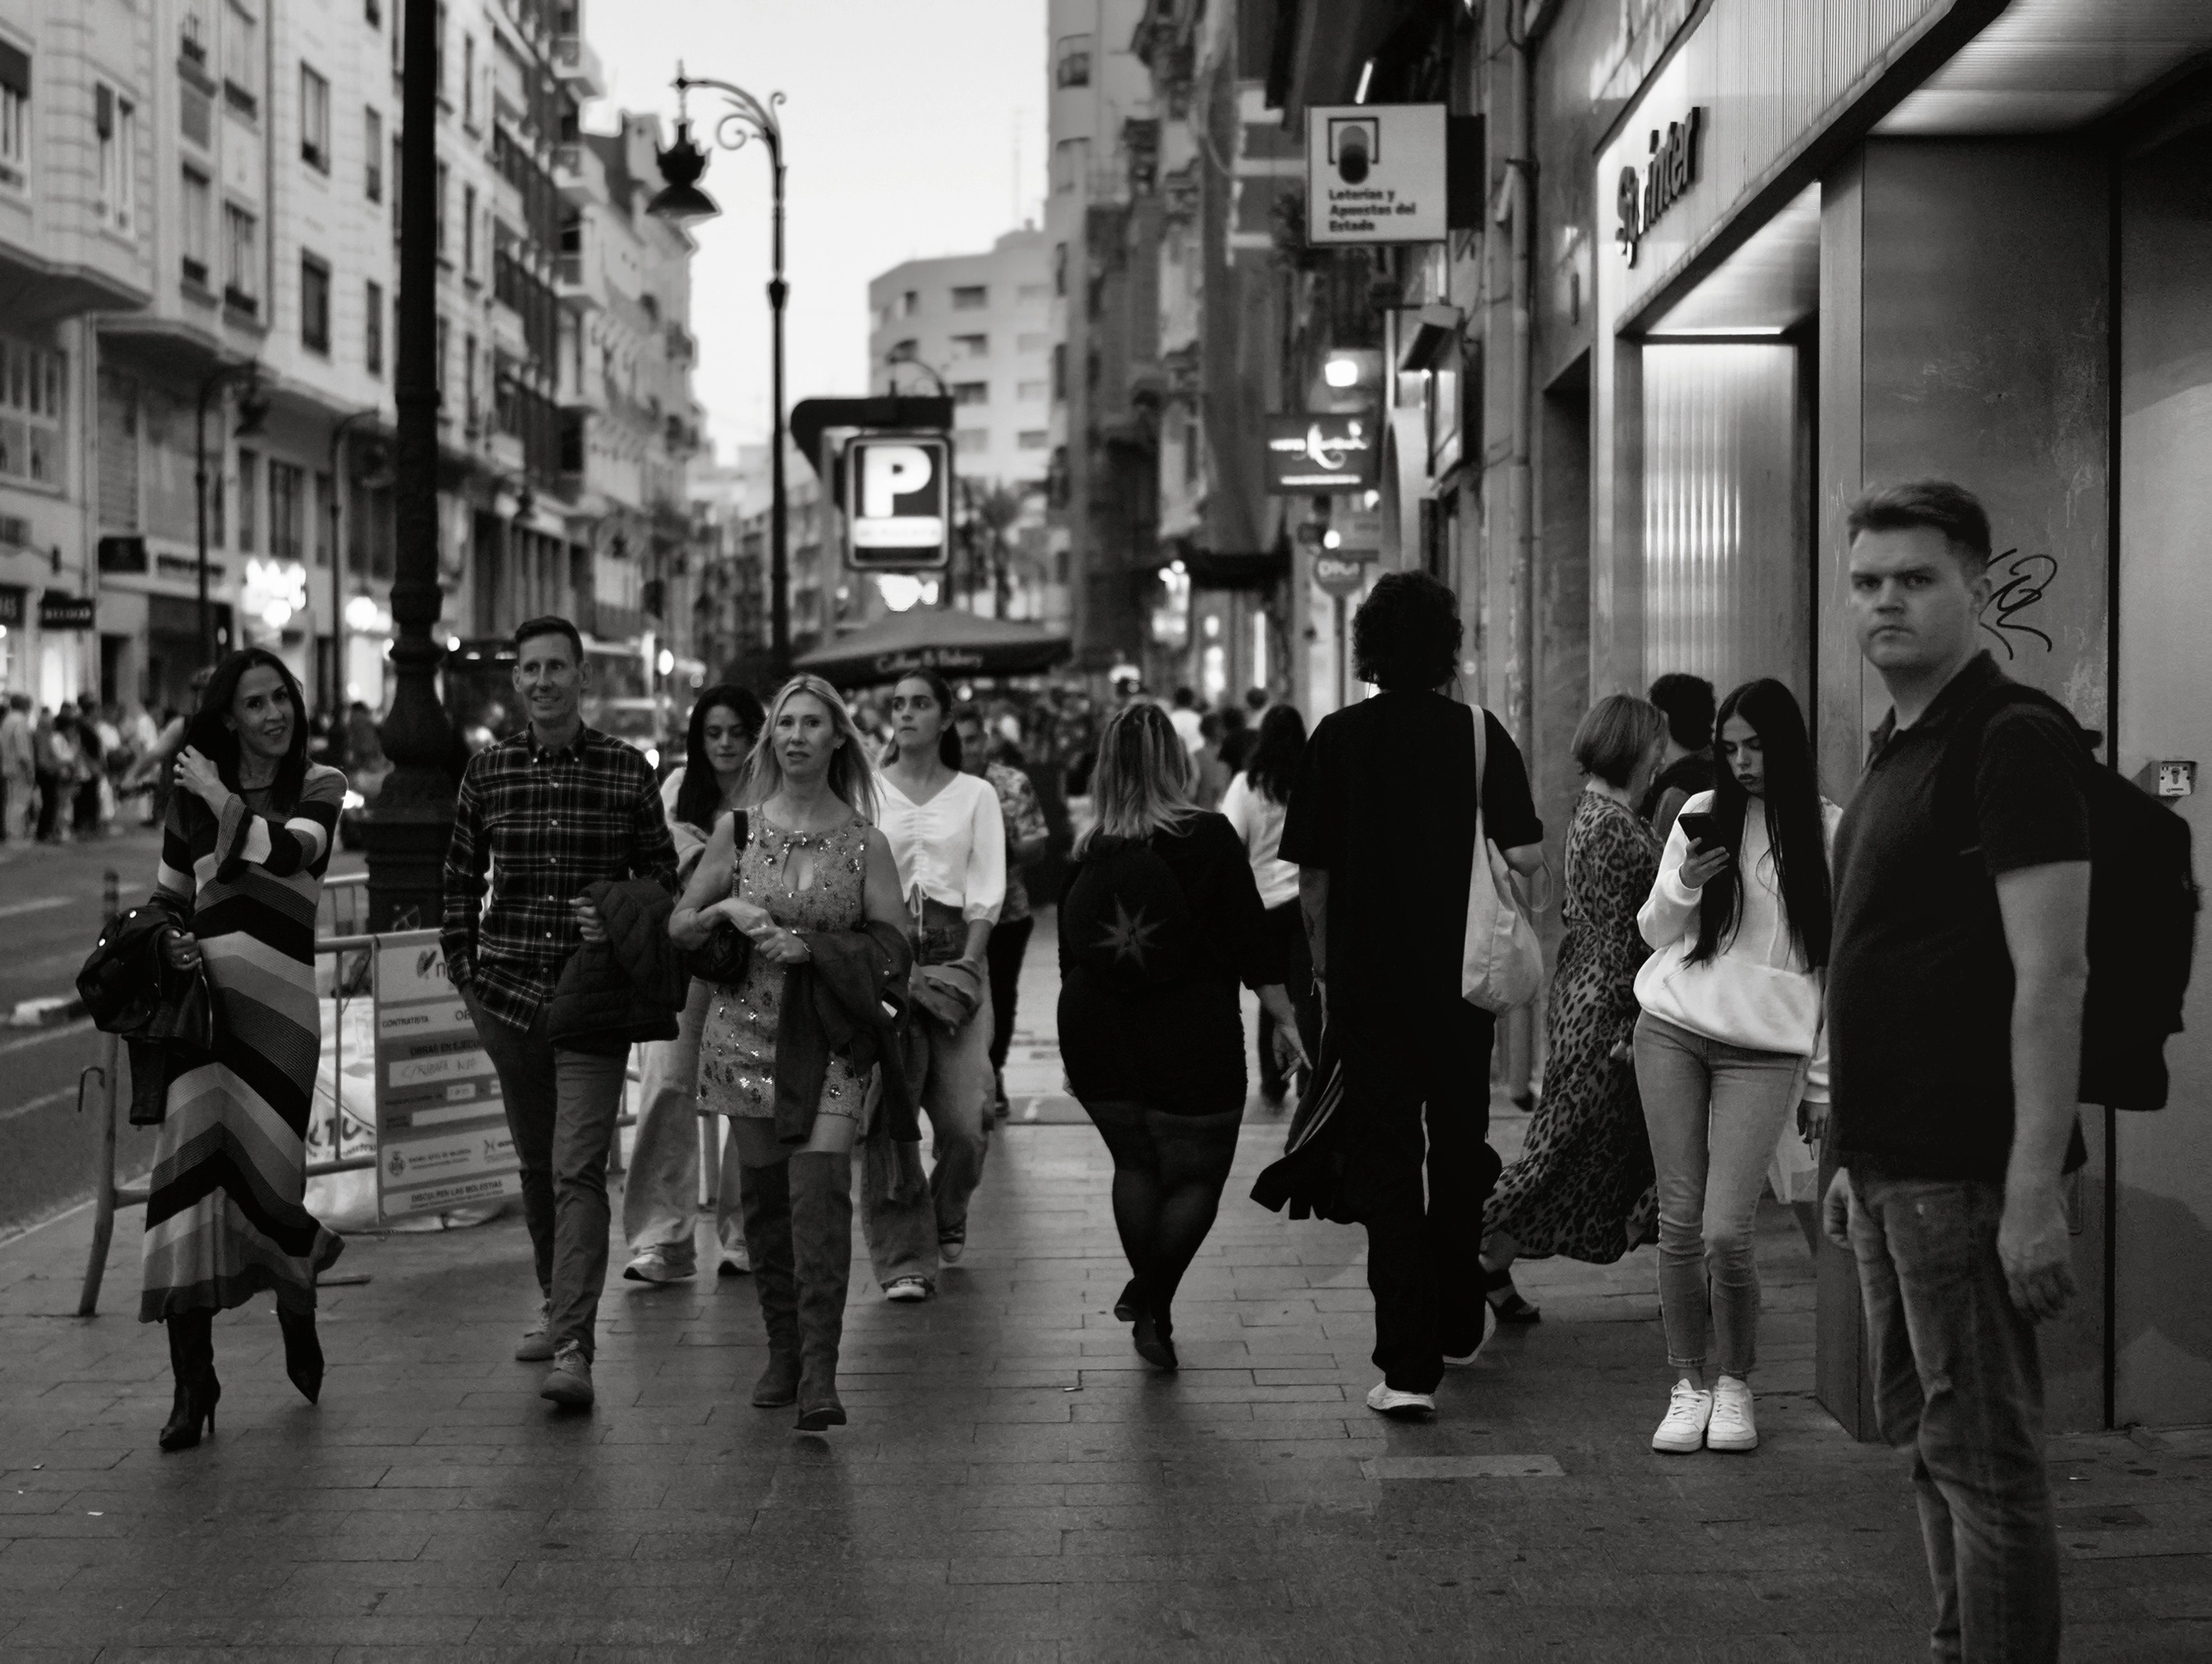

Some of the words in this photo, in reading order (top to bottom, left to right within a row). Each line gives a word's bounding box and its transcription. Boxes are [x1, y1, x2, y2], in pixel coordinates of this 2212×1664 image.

[1615, 107, 1700, 270] Sprinter
[1387, 190, 1395, 203] y
[1330, 205, 1392, 218] Apuestas
[1395, 202, 1416, 214] del
[1329, 219, 1376, 232] Estado
[864, 446, 932, 518] P
[382, 1015, 429, 1028] CONTRATISTA
[410, 1044, 439, 1056] OBRAS
[411, 1189, 449, 1203] DISCULPEN
[451, 1185, 464, 1196] LAS
[465, 1180, 503, 1194] MOLESTIAS
